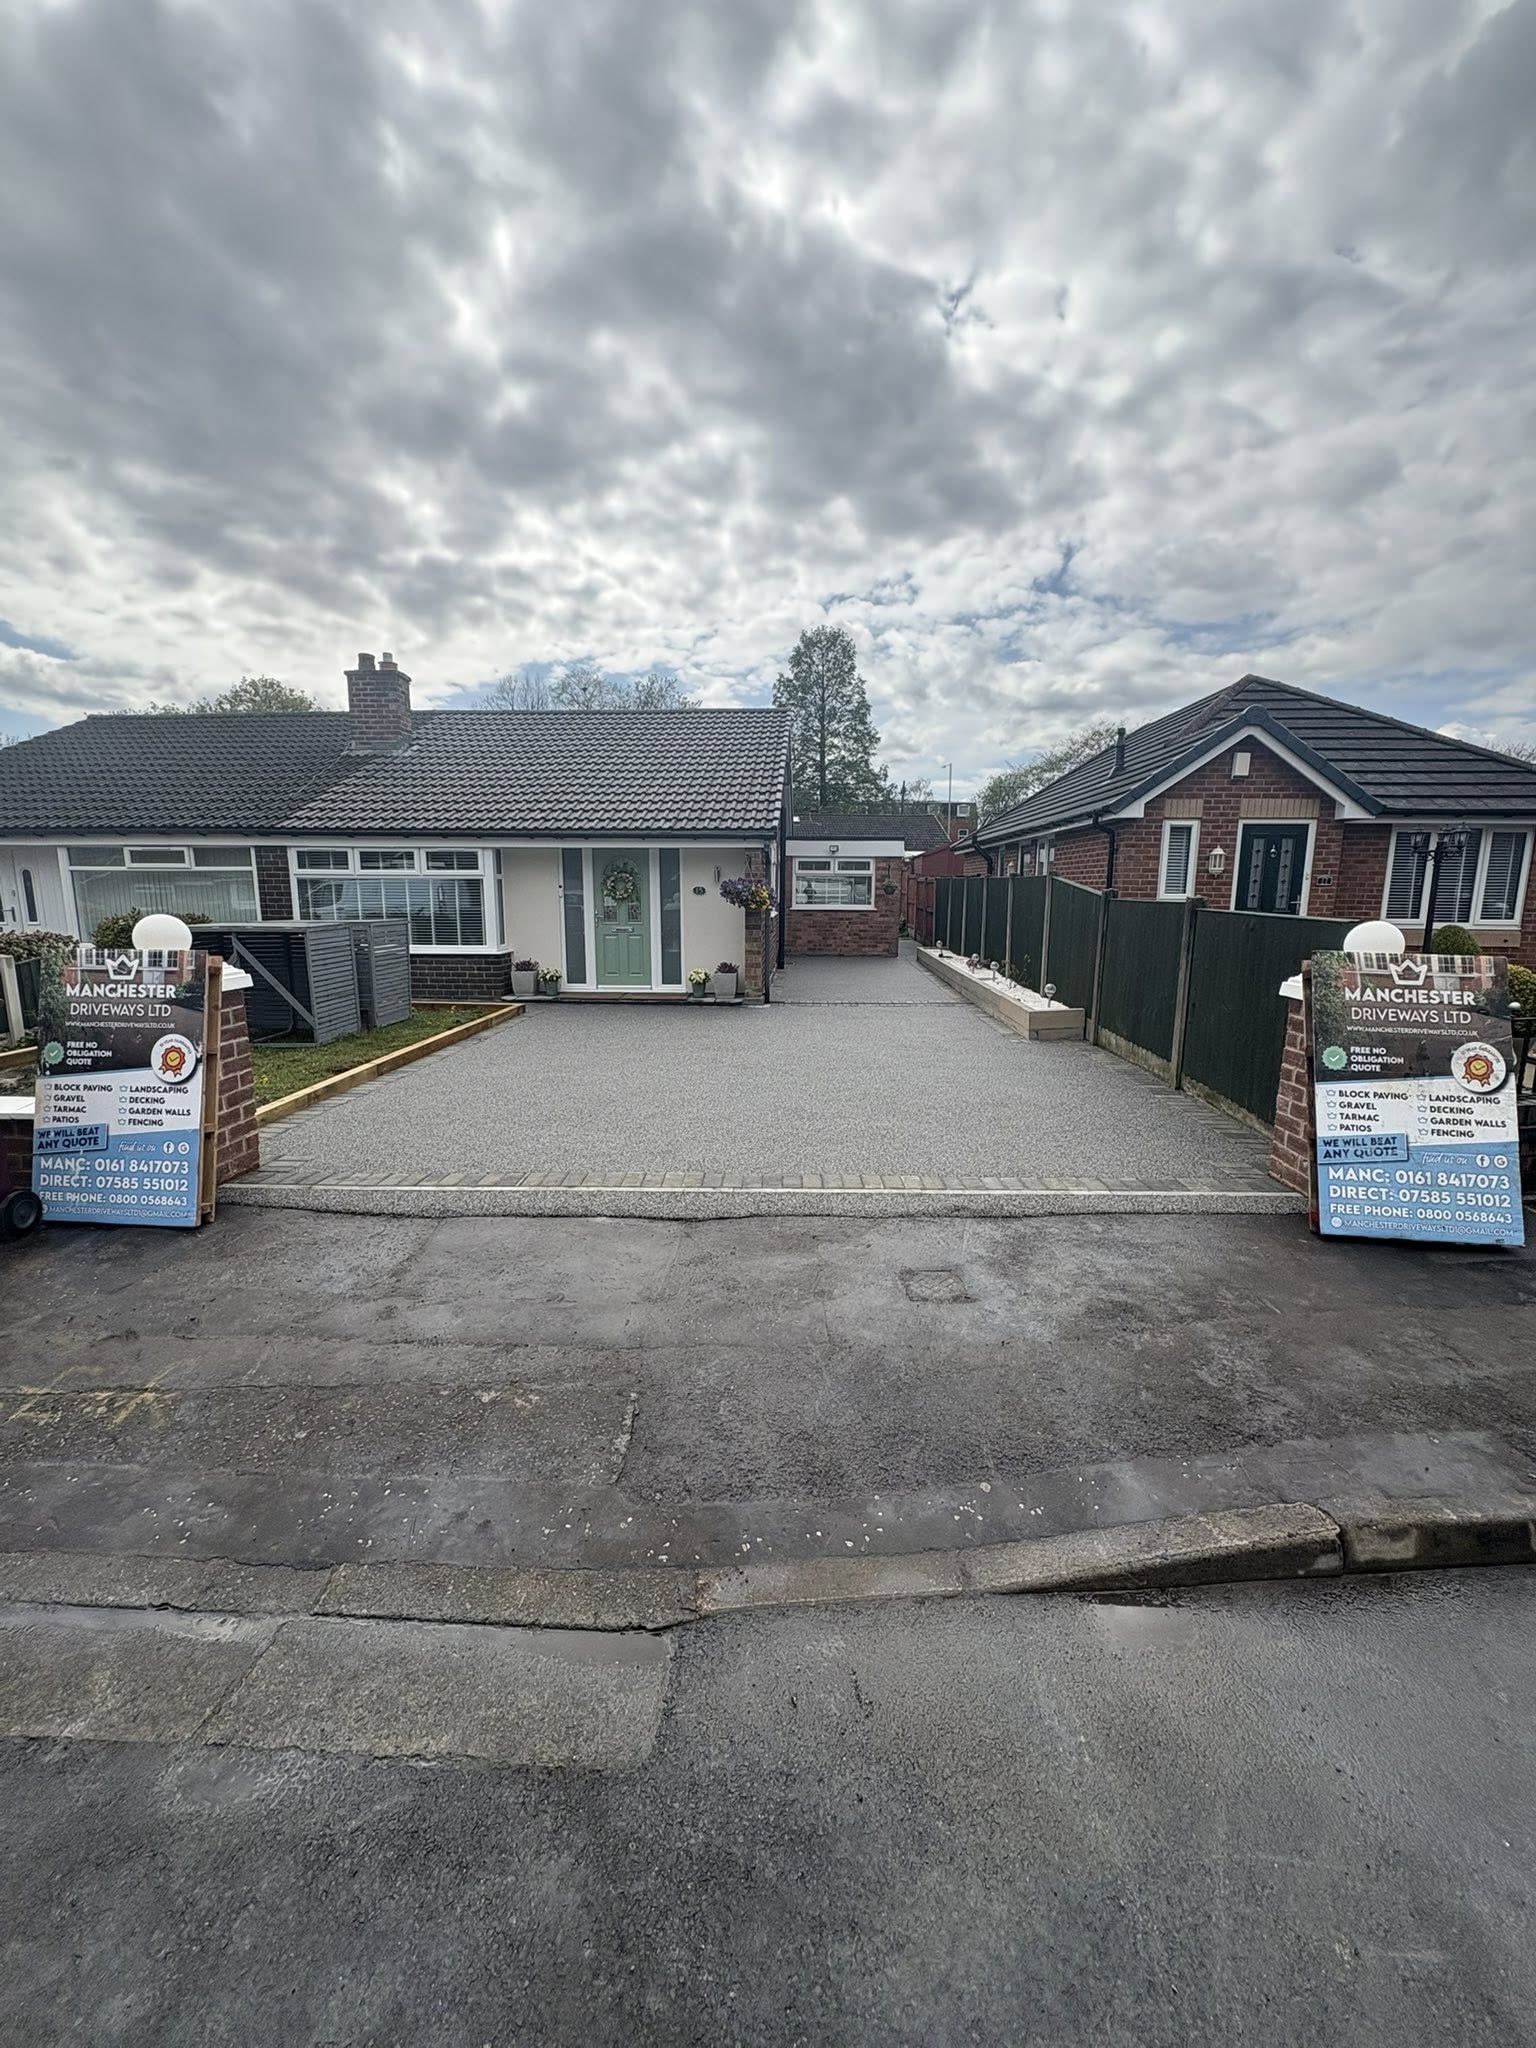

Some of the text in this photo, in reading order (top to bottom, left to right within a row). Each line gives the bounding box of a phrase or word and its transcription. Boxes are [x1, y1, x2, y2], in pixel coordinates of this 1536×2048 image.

[66, 983, 177, 998] MANCHESTER
[1345, 987, 1476, 1005] MANCHESTER
[70, 1003, 171, 1017] DRIVEWAYS LTD
[1351, 1008, 1471, 1024] DRIVEWAYS LTD
[1351, 1055, 1404, 1064] OBLIGATION
[1351, 1064, 1381, 1072] QUOTE
[1339, 1090, 1408, 1100] BLOCK PAVING
[1429, 1094, 1501, 1104] LANDSCAPING
[1339, 1102, 1377, 1110] GRAVEL
[1430, 1106, 1474, 1115] DECKING
[1340, 1113, 1379, 1121] TARMAC
[1430, 1117, 1506, 1128] GARDEN WALLS
[54, 1129, 74, 1138] WILL
[78, 1127, 99, 1136] BEAT
[1340, 1124, 1372, 1132] PATIOS
[1431, 1129, 1474, 1137] FENCING
[38, 1136, 99, 1149] ANY QUOTE
[1323, 1137, 1397, 1148] WE WILL BEAT
[1323, 1147, 1398, 1159] ANY QUOTE
[40, 1157, 189, 1174] MANC: 0161 8417073
[40, 1174, 188, 1191] DIRECT: 07585 551012
[1328, 1166, 1510, 1189] MANC: 0161 8417073
[40, 1192, 187, 1205] FREE PHONE: 0800 0568643
[1330, 1185, 1511, 1208] DIRECT: 07585 551012
[1330, 1204, 1512, 1224] FREE PHONE: 0800 0568643
